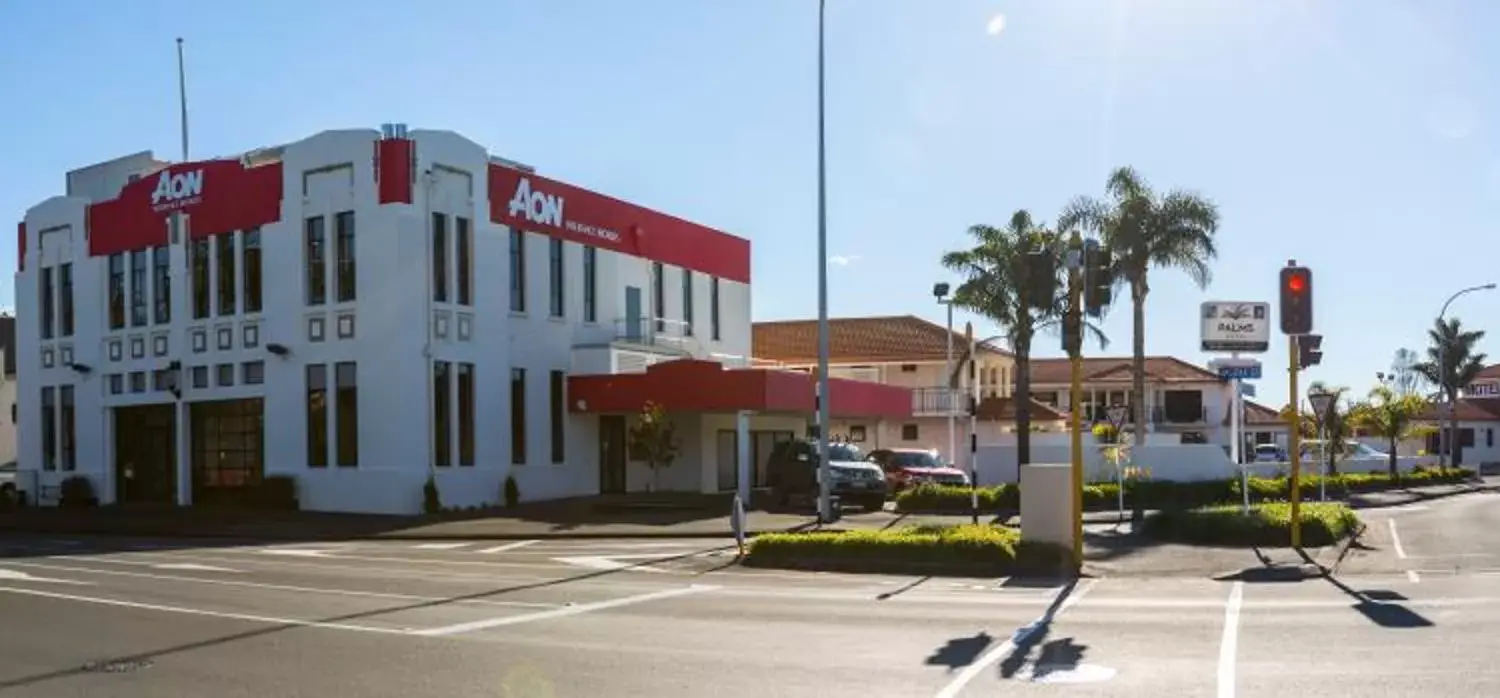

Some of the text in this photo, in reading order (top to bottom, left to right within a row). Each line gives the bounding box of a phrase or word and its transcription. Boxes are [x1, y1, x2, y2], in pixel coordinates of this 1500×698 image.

[151, 169, 204, 205] AON
[509, 178, 564, 227] AON
[1217, 322, 1255, 332] PALMS
